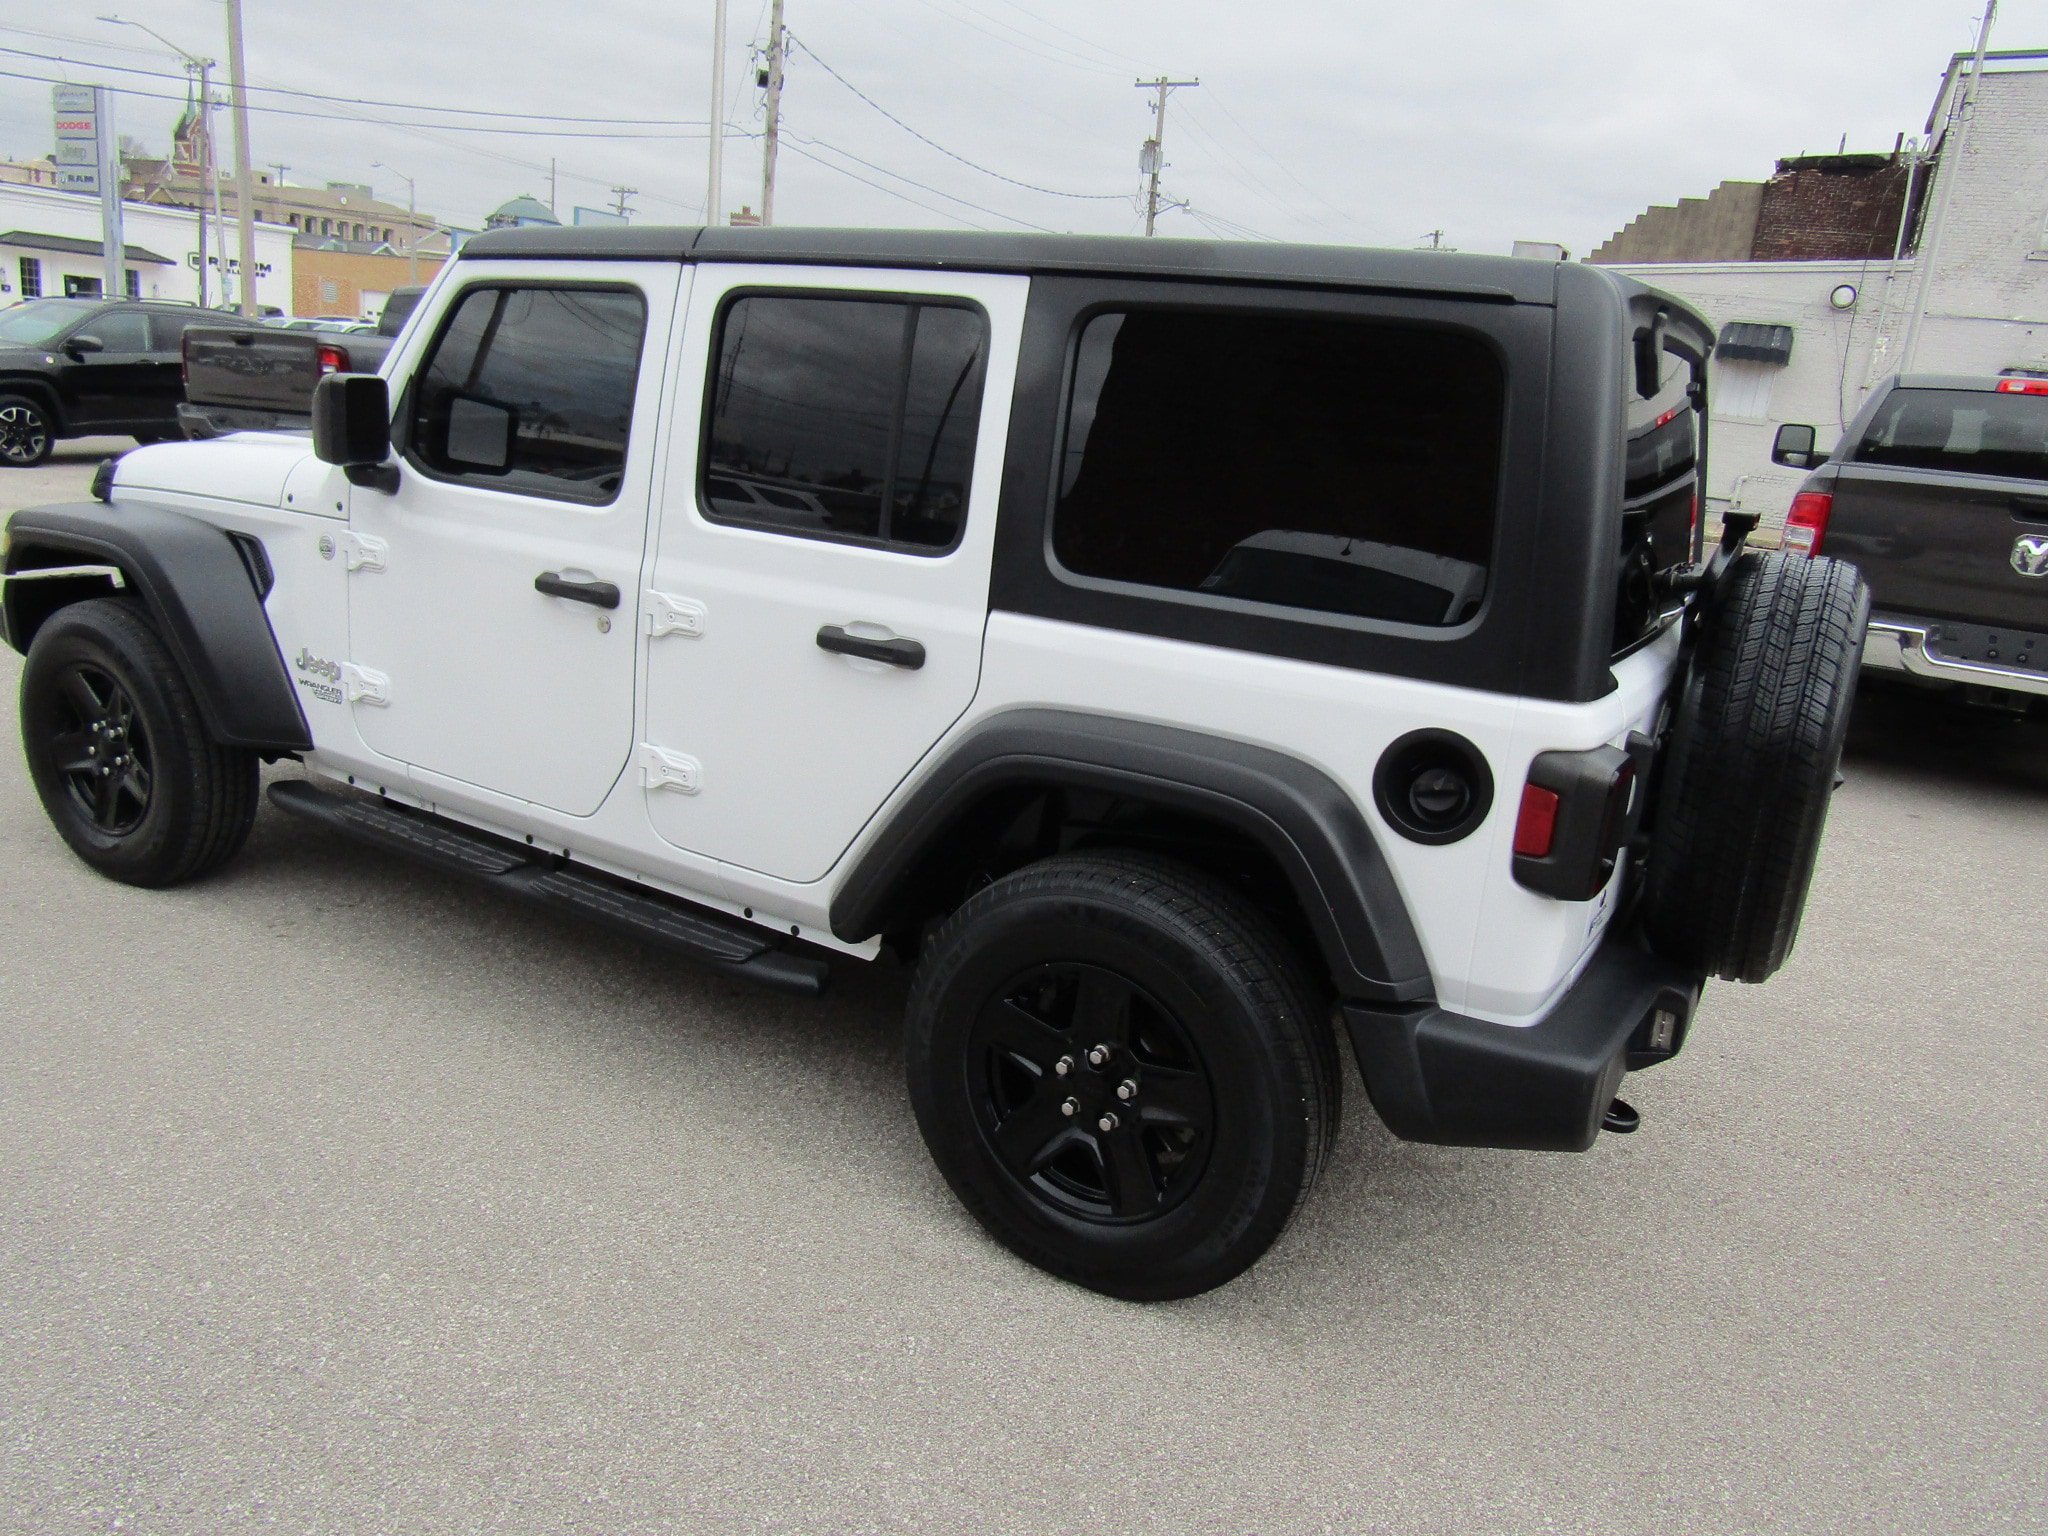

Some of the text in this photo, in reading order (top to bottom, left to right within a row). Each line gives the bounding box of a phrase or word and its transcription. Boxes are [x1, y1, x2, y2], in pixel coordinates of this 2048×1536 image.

[56, 121, 92, 130] DODGE
[67, 174, 94, 184] RAM
[296, 647, 342, 684] Jeep
